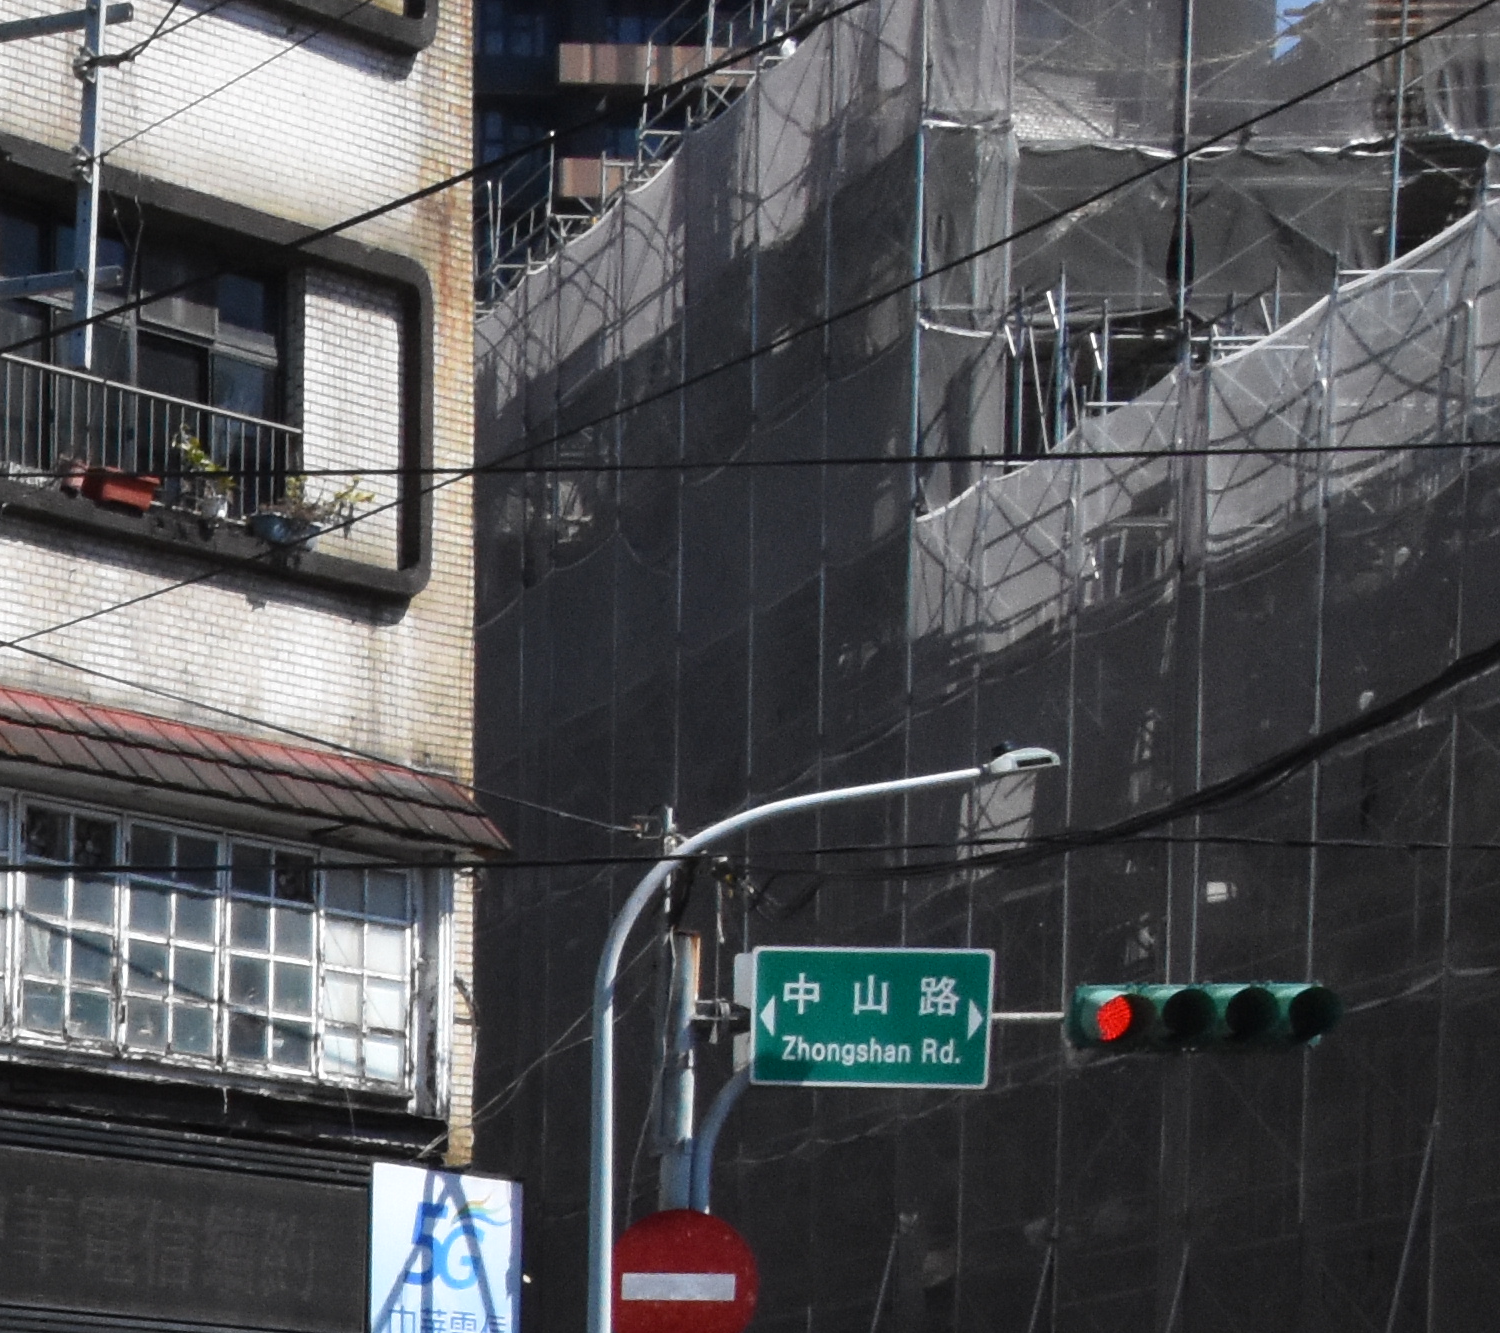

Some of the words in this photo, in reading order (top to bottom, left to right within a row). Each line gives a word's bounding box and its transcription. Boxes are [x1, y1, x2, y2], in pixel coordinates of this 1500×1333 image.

[783, 973, 960, 1017] 中山路
[782, 1036, 911, 1067] Zhongshan
[922, 1038, 961, 1066] Rd.
[402, 1202, 485, 1290] 5G
